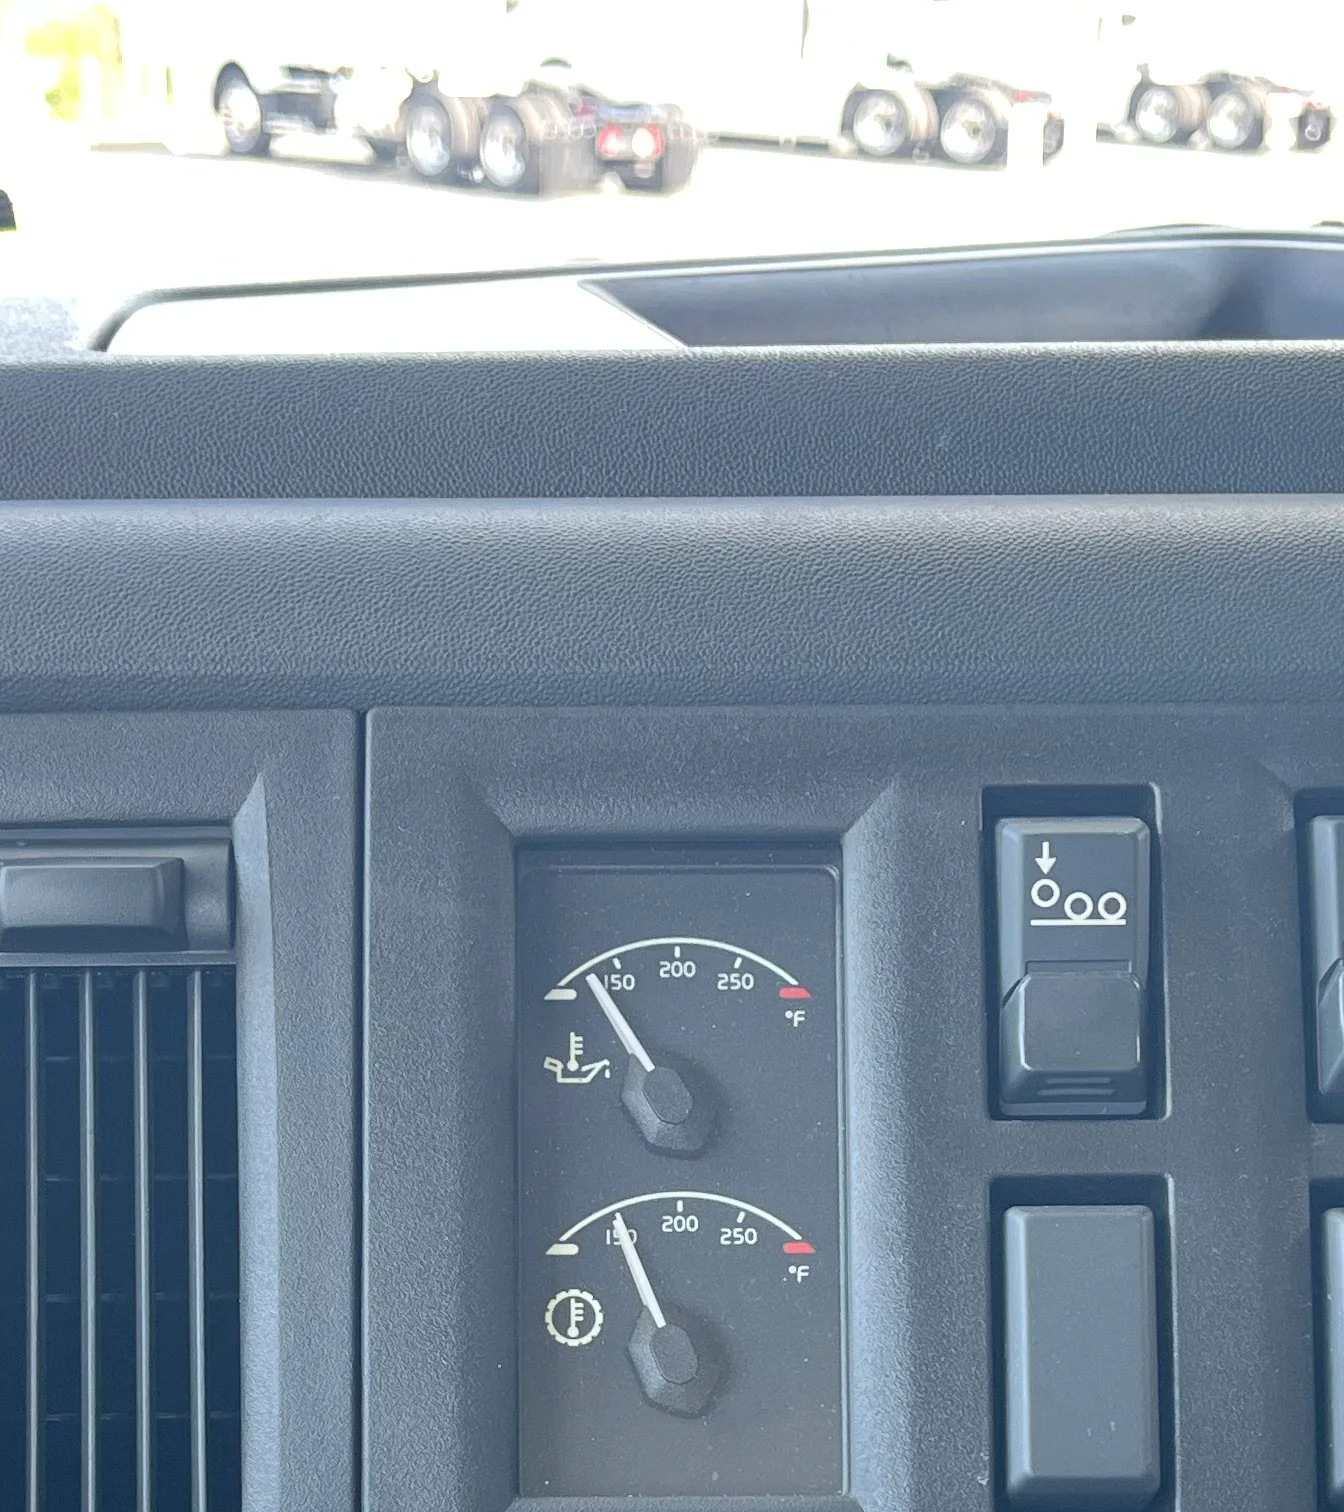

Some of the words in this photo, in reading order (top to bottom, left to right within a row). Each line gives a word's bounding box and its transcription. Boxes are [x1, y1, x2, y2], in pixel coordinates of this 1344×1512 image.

[659, 960, 696, 978] 200
[604, 973, 635, 990] 150
[717, 973, 754, 990] 250
[661, 1215, 698, 1233] 200
[720, 1227, 757, 1245] 250
